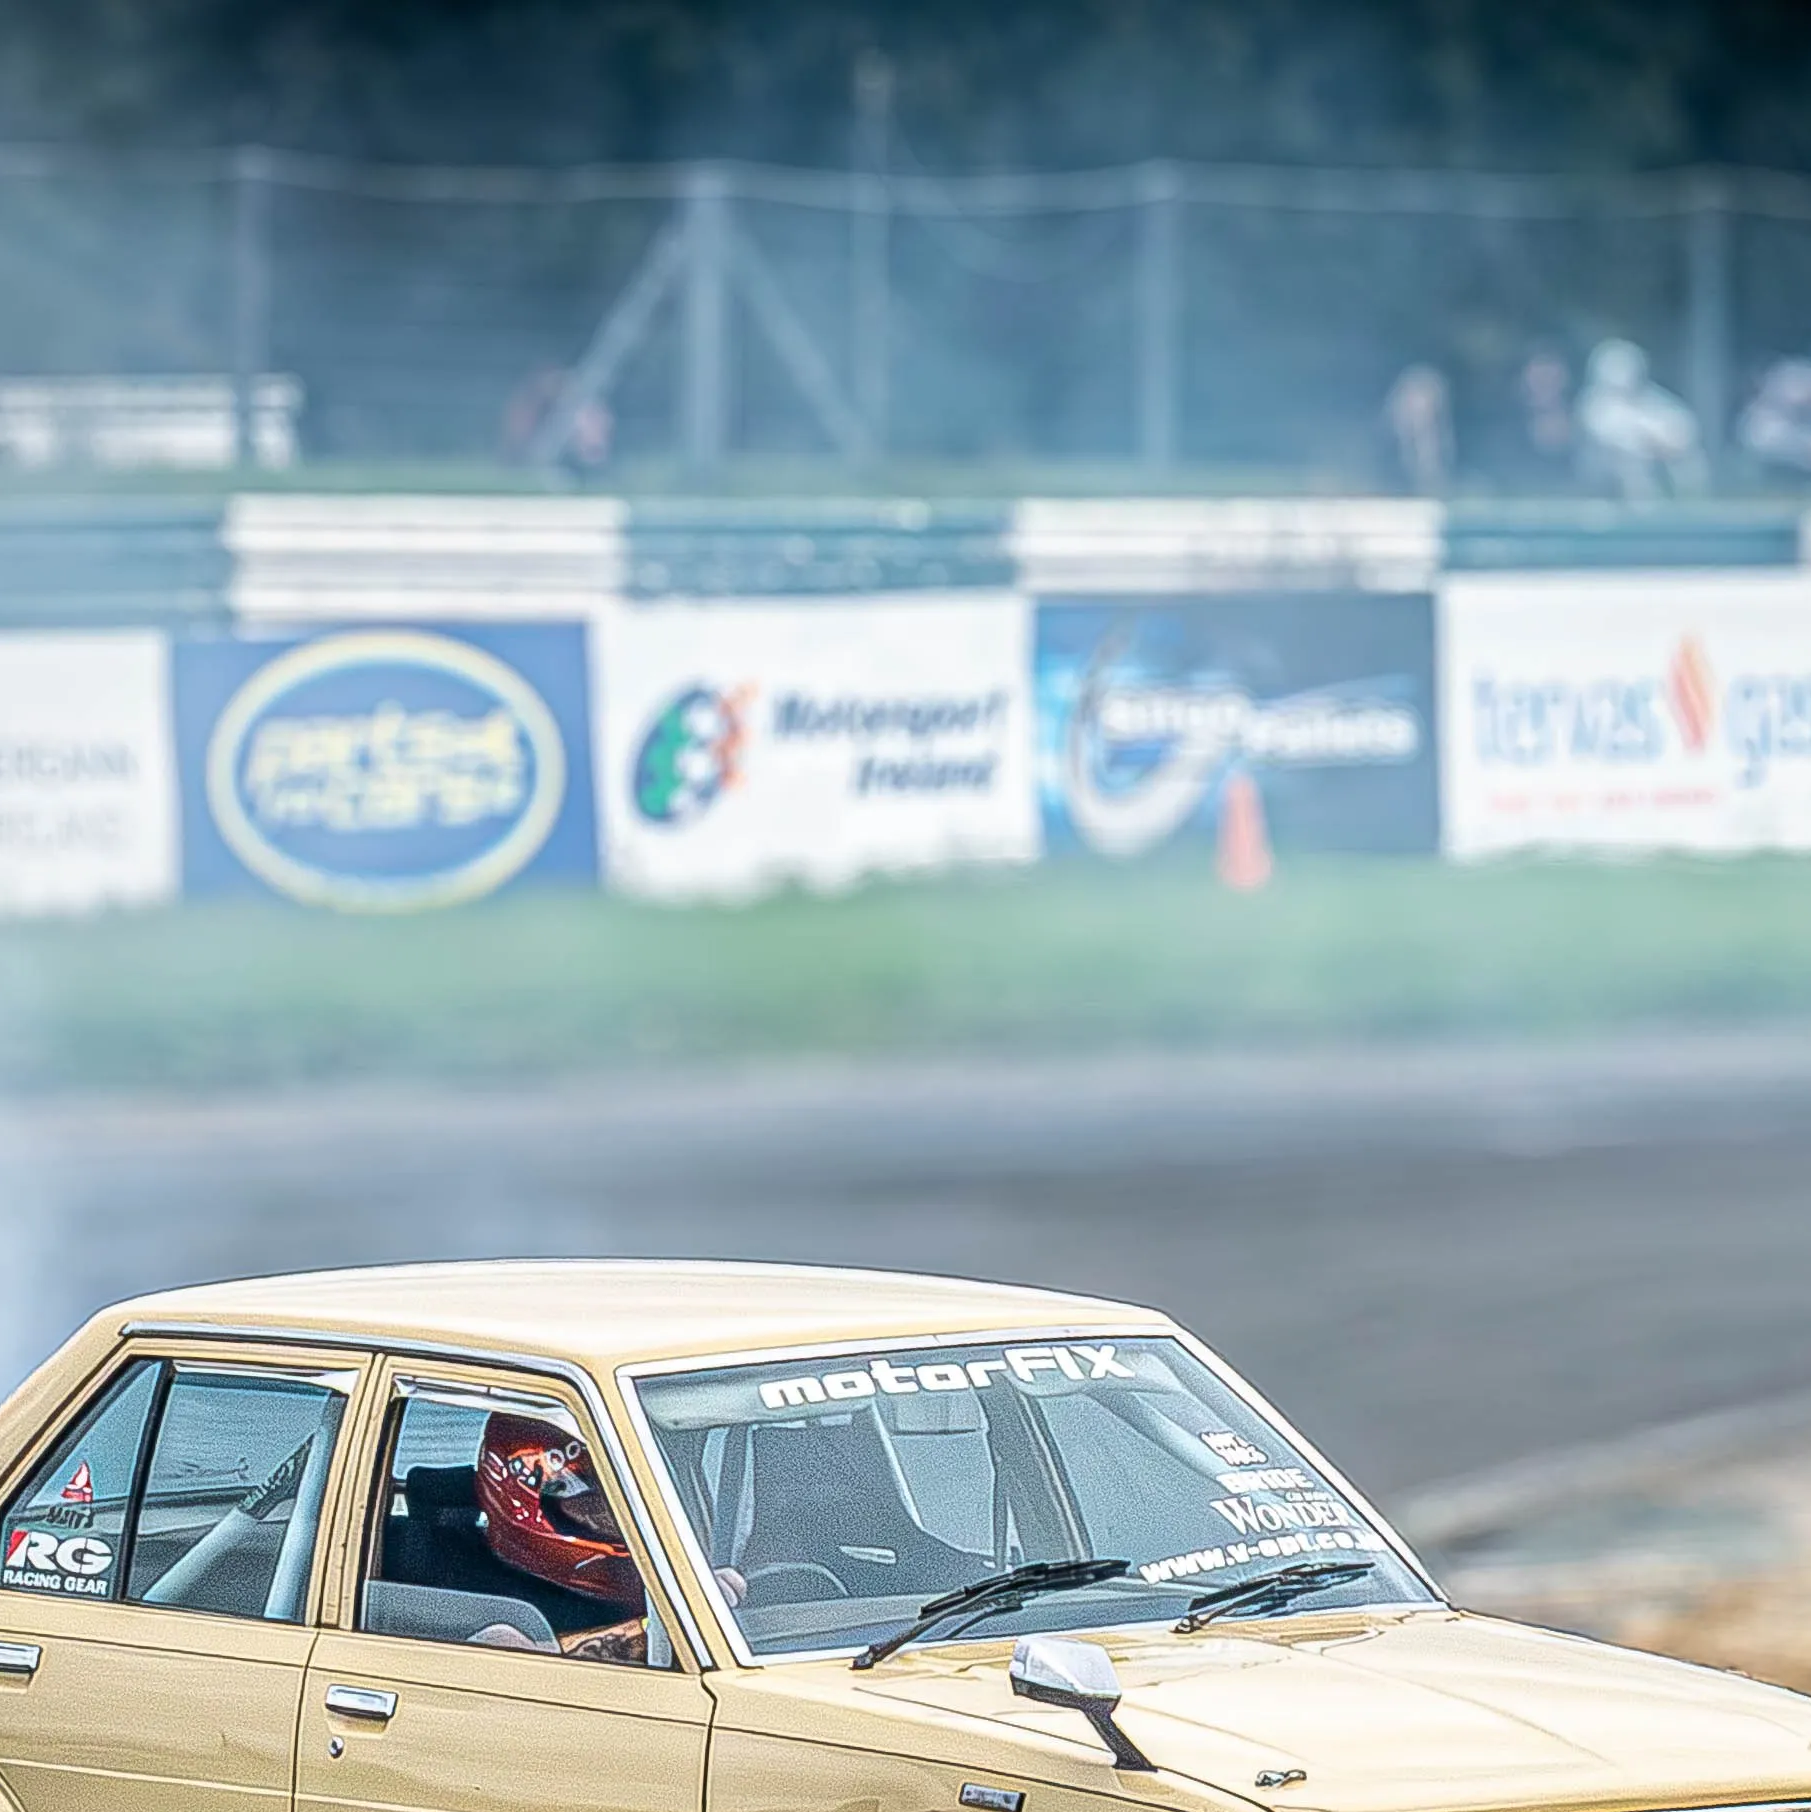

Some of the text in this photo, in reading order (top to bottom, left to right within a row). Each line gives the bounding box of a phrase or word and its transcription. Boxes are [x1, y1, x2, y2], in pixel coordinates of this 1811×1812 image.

[1216, 1468, 1315, 1494] BRIDE
[1210, 1496, 1356, 1536] WONDER
[6, 1530, 114, 1575] RG
[3, 1569, 108, 1596] RACING GEAR
